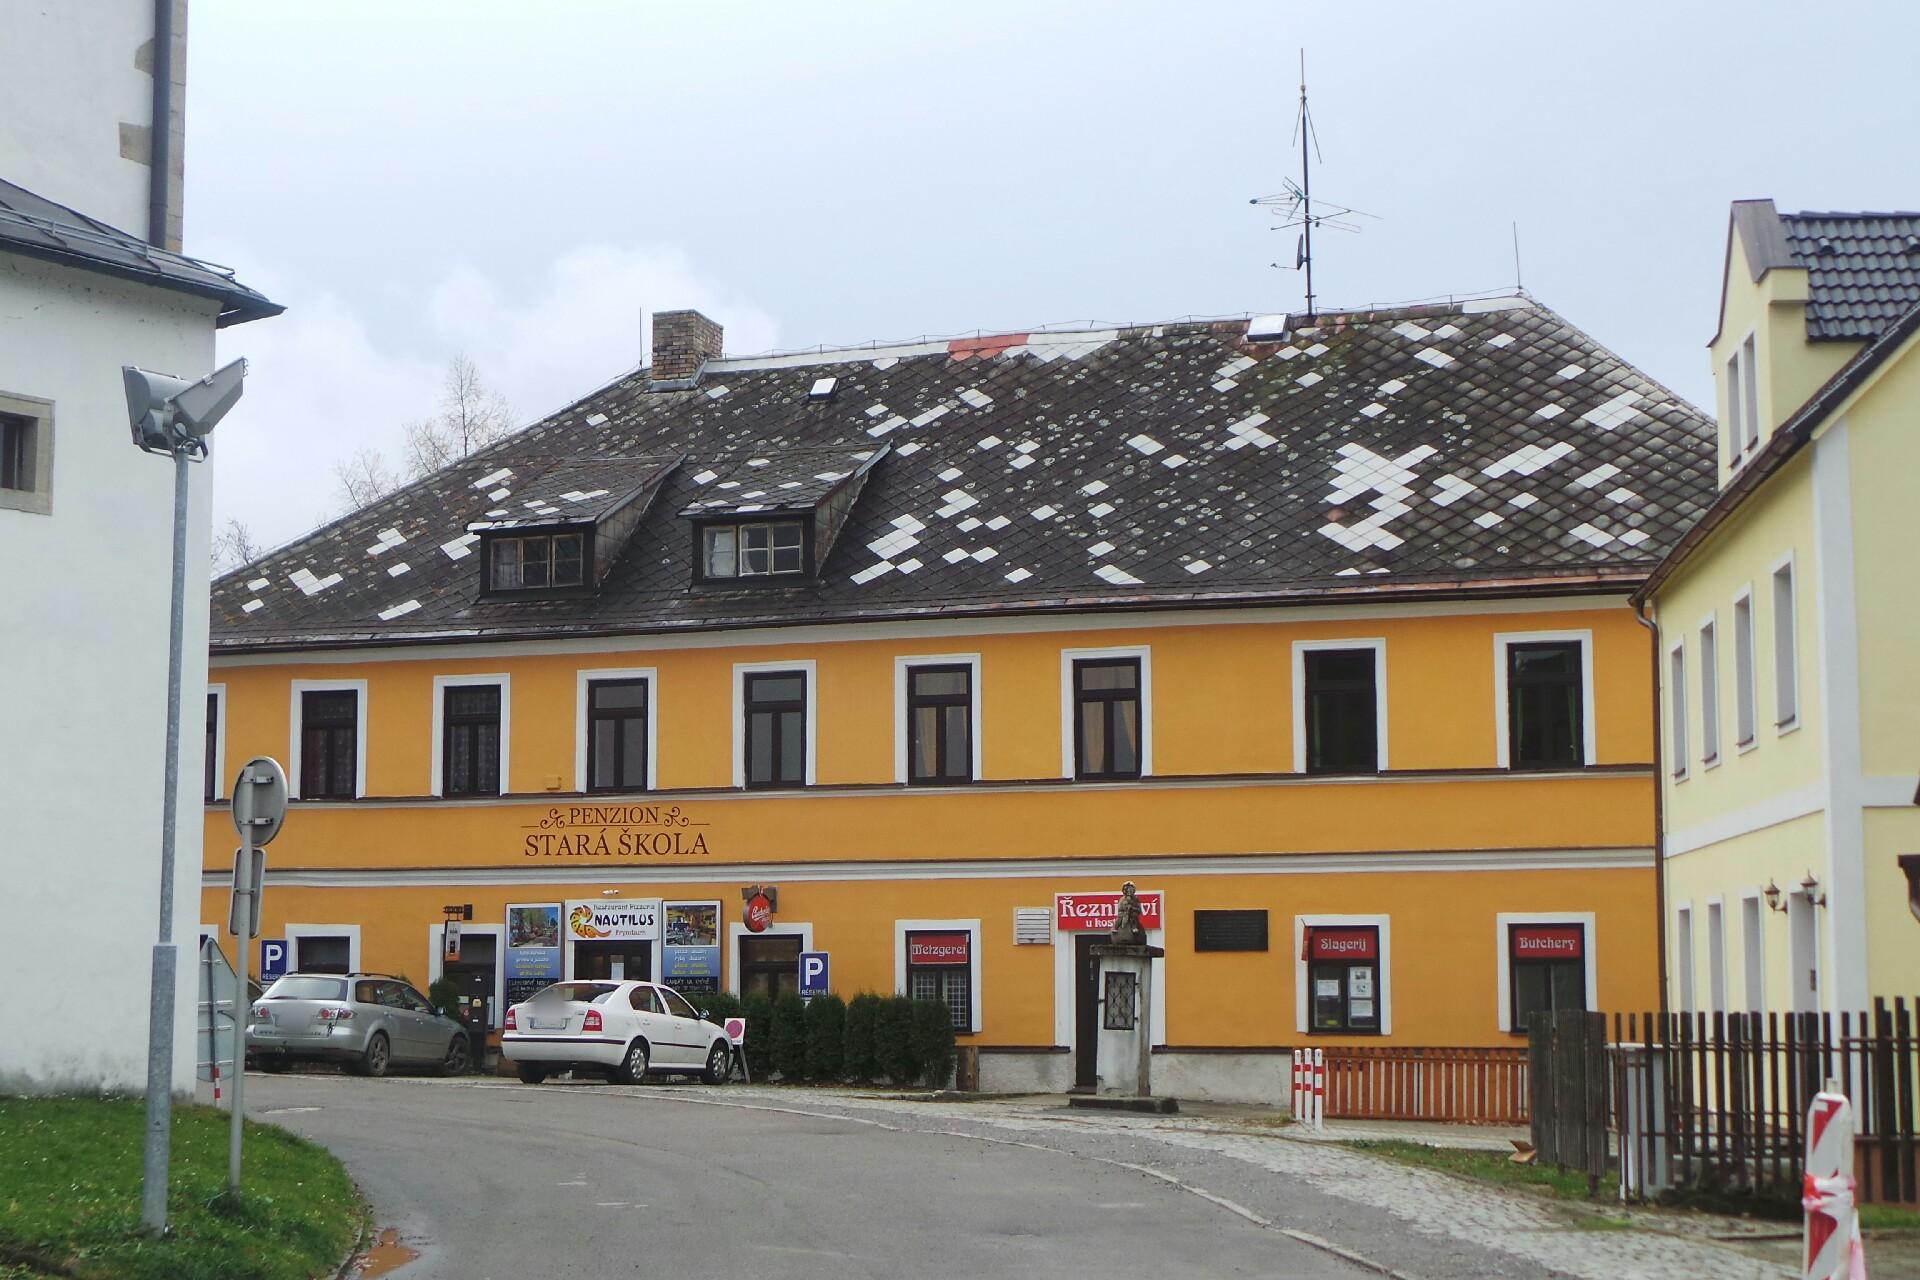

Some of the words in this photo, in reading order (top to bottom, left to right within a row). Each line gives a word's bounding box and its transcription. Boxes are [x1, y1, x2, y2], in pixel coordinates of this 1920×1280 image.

[569, 806, 660, 825] PENZION
[524, 828, 612, 857] STARÁ
[618, 827, 709, 856] ŠKOLA
[1059, 896, 1158, 917] Řezniví
[594, 914, 654, 926] NAUTILUS
[1086, 920, 1092, 928] u
[911, 943, 966, 957] Metzgerei
[1320, 938, 1367, 951] Slagerij
[1519, 937, 1575, 951] Butchery
[265, 944, 283, 971] P
[805, 957, 824, 986] P
